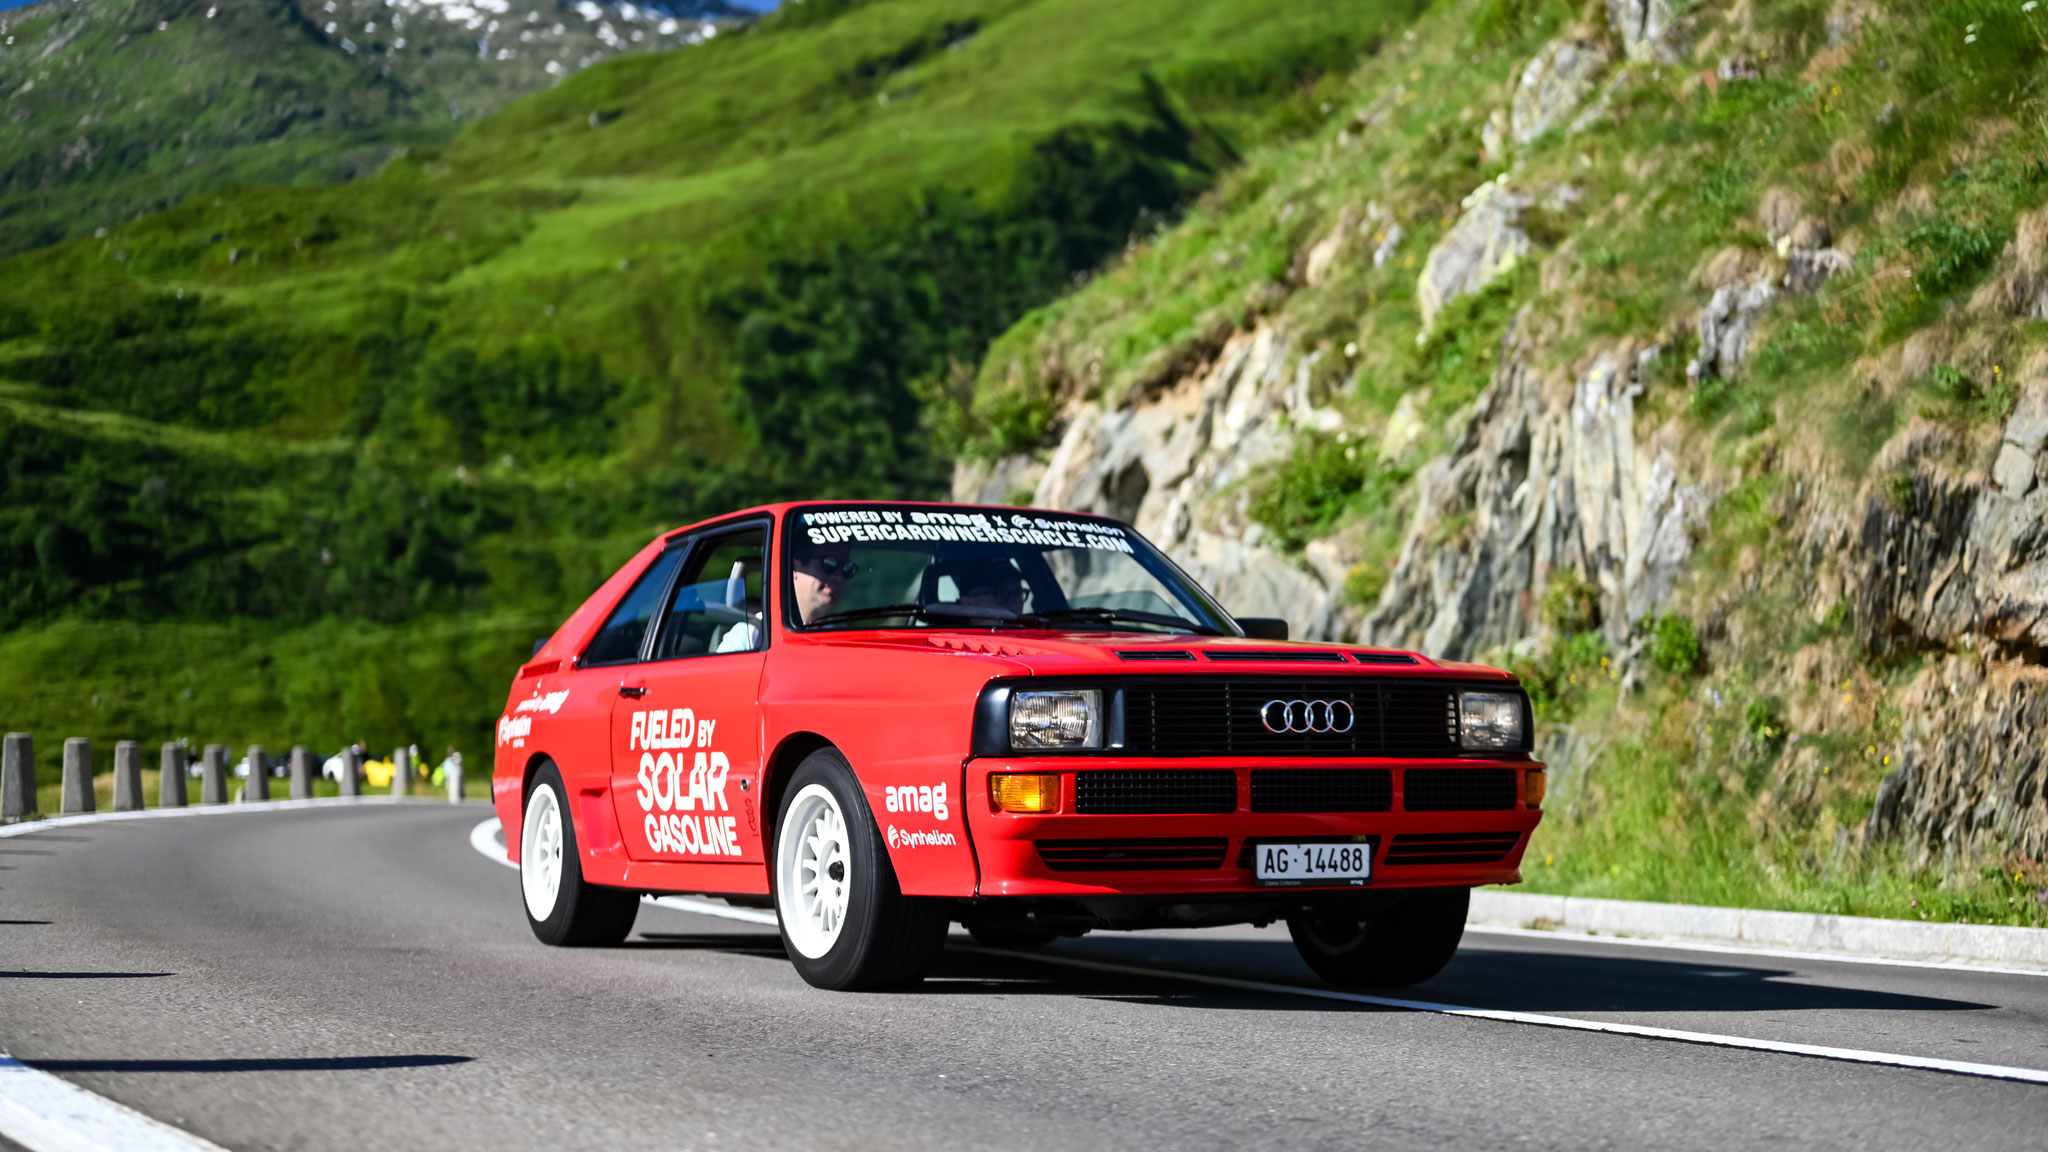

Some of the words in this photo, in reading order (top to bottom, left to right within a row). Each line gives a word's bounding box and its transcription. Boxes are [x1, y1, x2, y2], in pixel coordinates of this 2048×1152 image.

[803, 511, 881, 526] POWERED
[881, 511, 904, 523] BY
[1034, 518, 1126, 538] Synhelion
[807, 524, 1135, 554] SUPERCAROWNERSCIRCLE.COM
[630, 708, 695, 750] FUELED
[697, 719, 716, 747] BY
[636, 751, 730, 811] SOLAR
[885, 781, 949, 820] amag
[644, 813, 742, 856] GASOLINE
[900, 829, 956, 849] Synhelion
